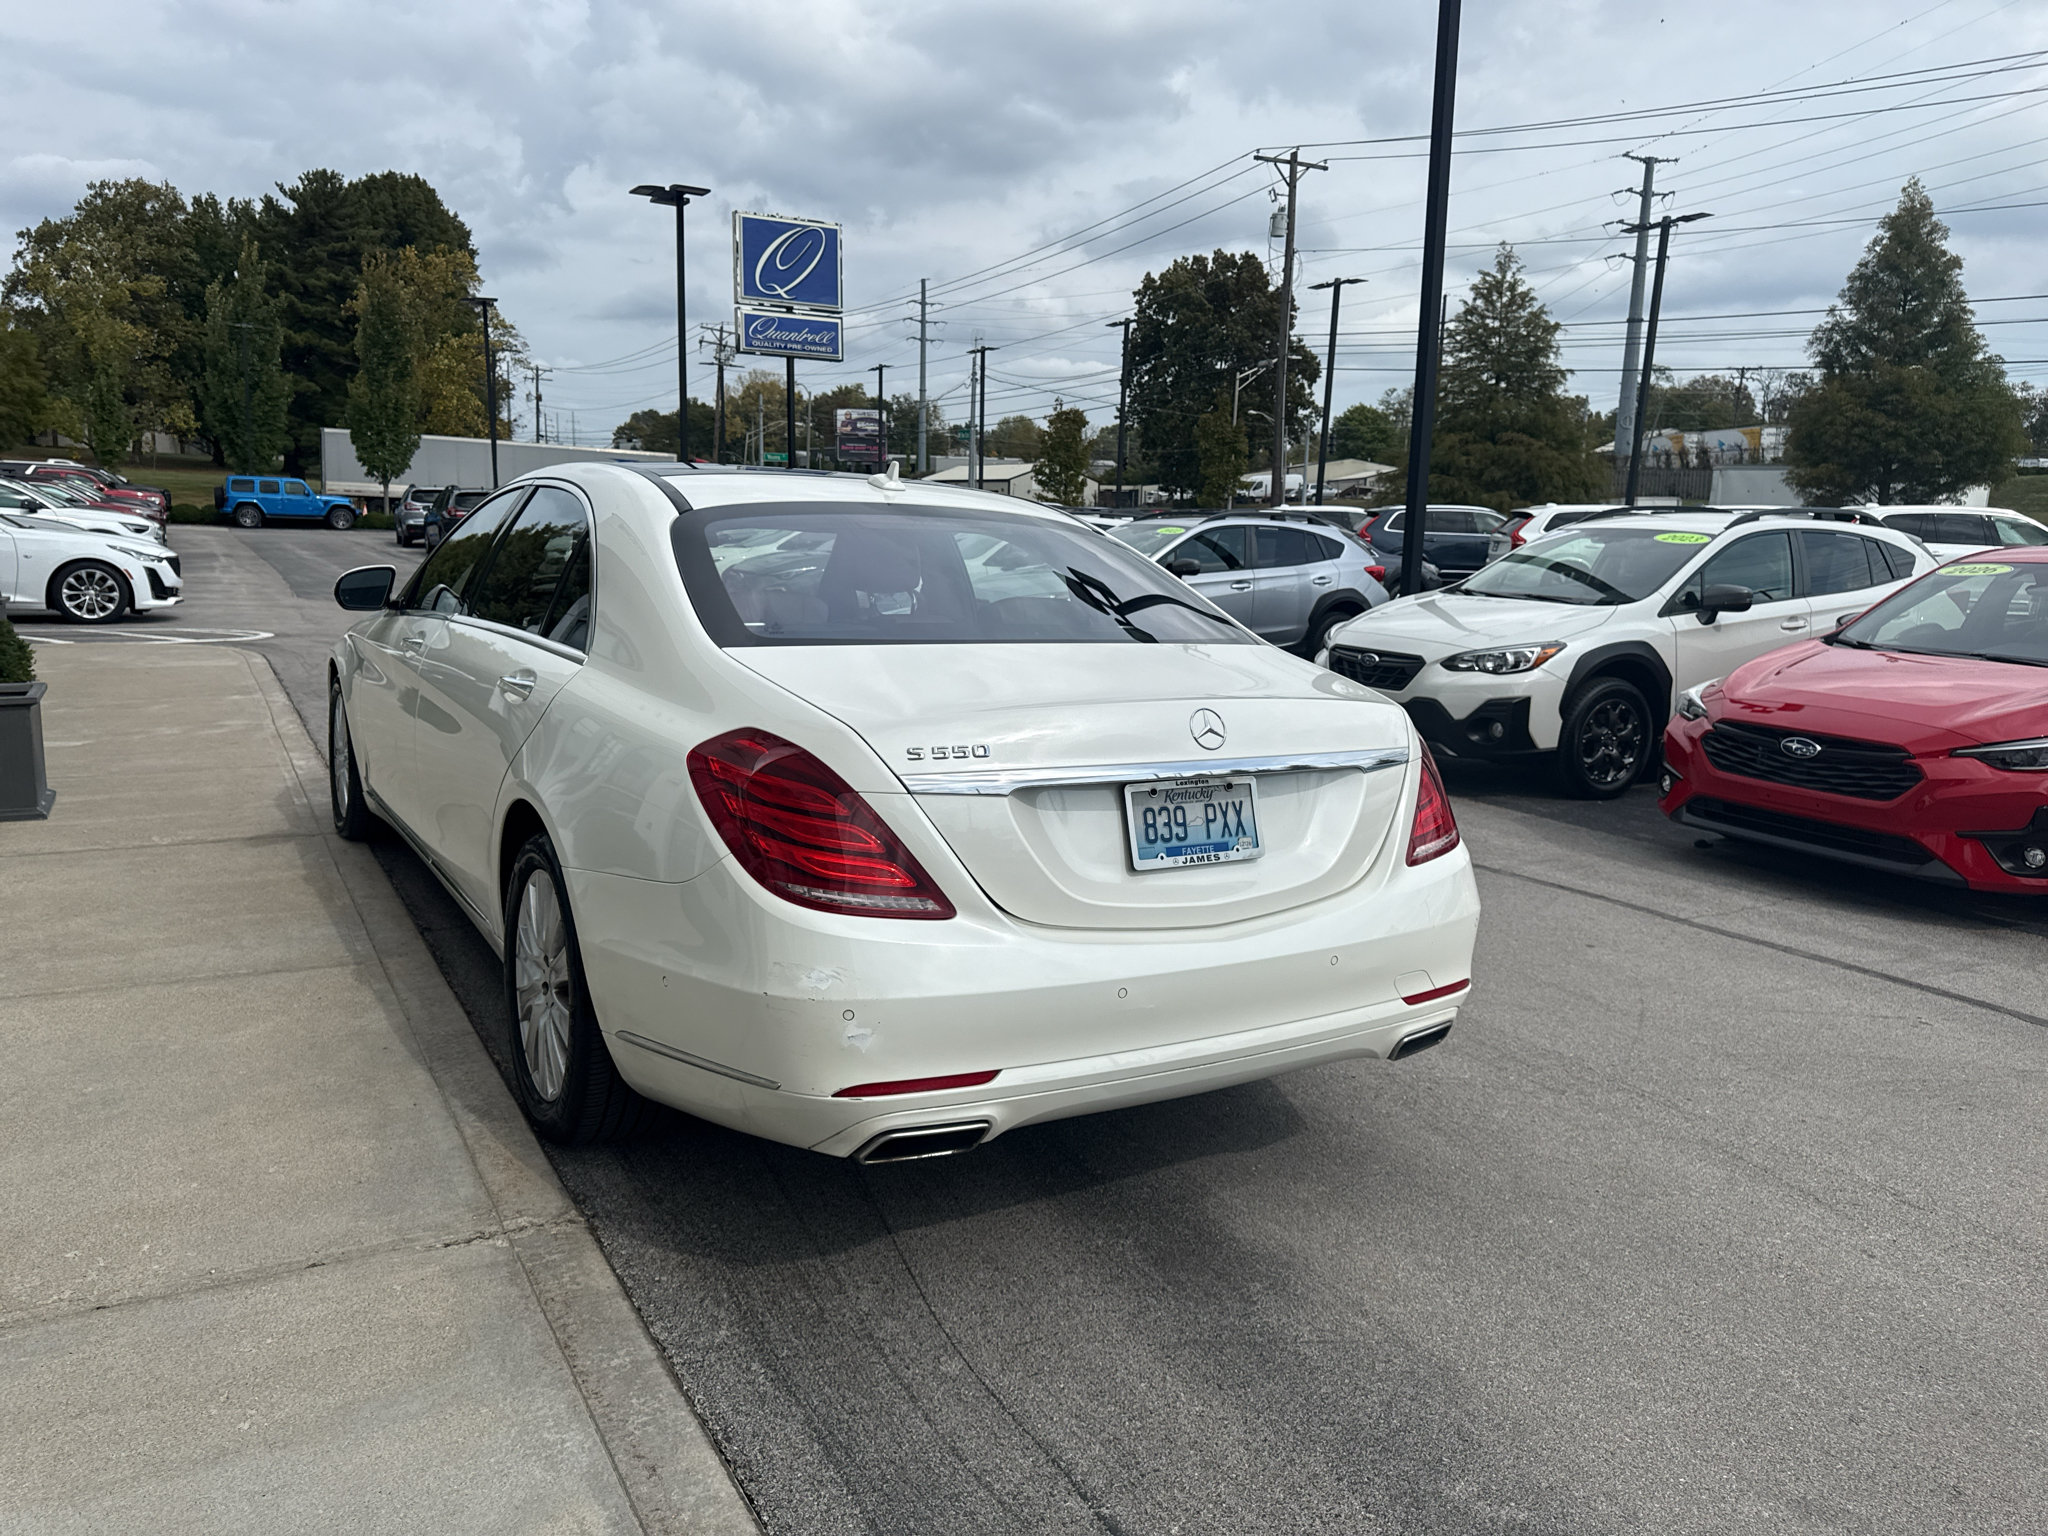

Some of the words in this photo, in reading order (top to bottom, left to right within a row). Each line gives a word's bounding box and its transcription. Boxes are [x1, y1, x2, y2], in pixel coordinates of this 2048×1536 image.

[755, 226, 826, 299] Q
[749, 317, 836, 344] Quantrell
[752, 340, 785, 349] QUALITY
[787, 343, 833, 353] PRE-OWNED
[906, 747, 926, 761] S
[931, 744, 991, 760] 550
[1175, 779, 1210, 787] Lexington
[1164, 787, 1214, 805] Kentucky
[1143, 805, 1188, 844] 839
[1204, 800, 1247, 840] PXX
[1181, 845, 1215, 856] FAYETTE
[1181, 854, 1221, 865] JAMES
